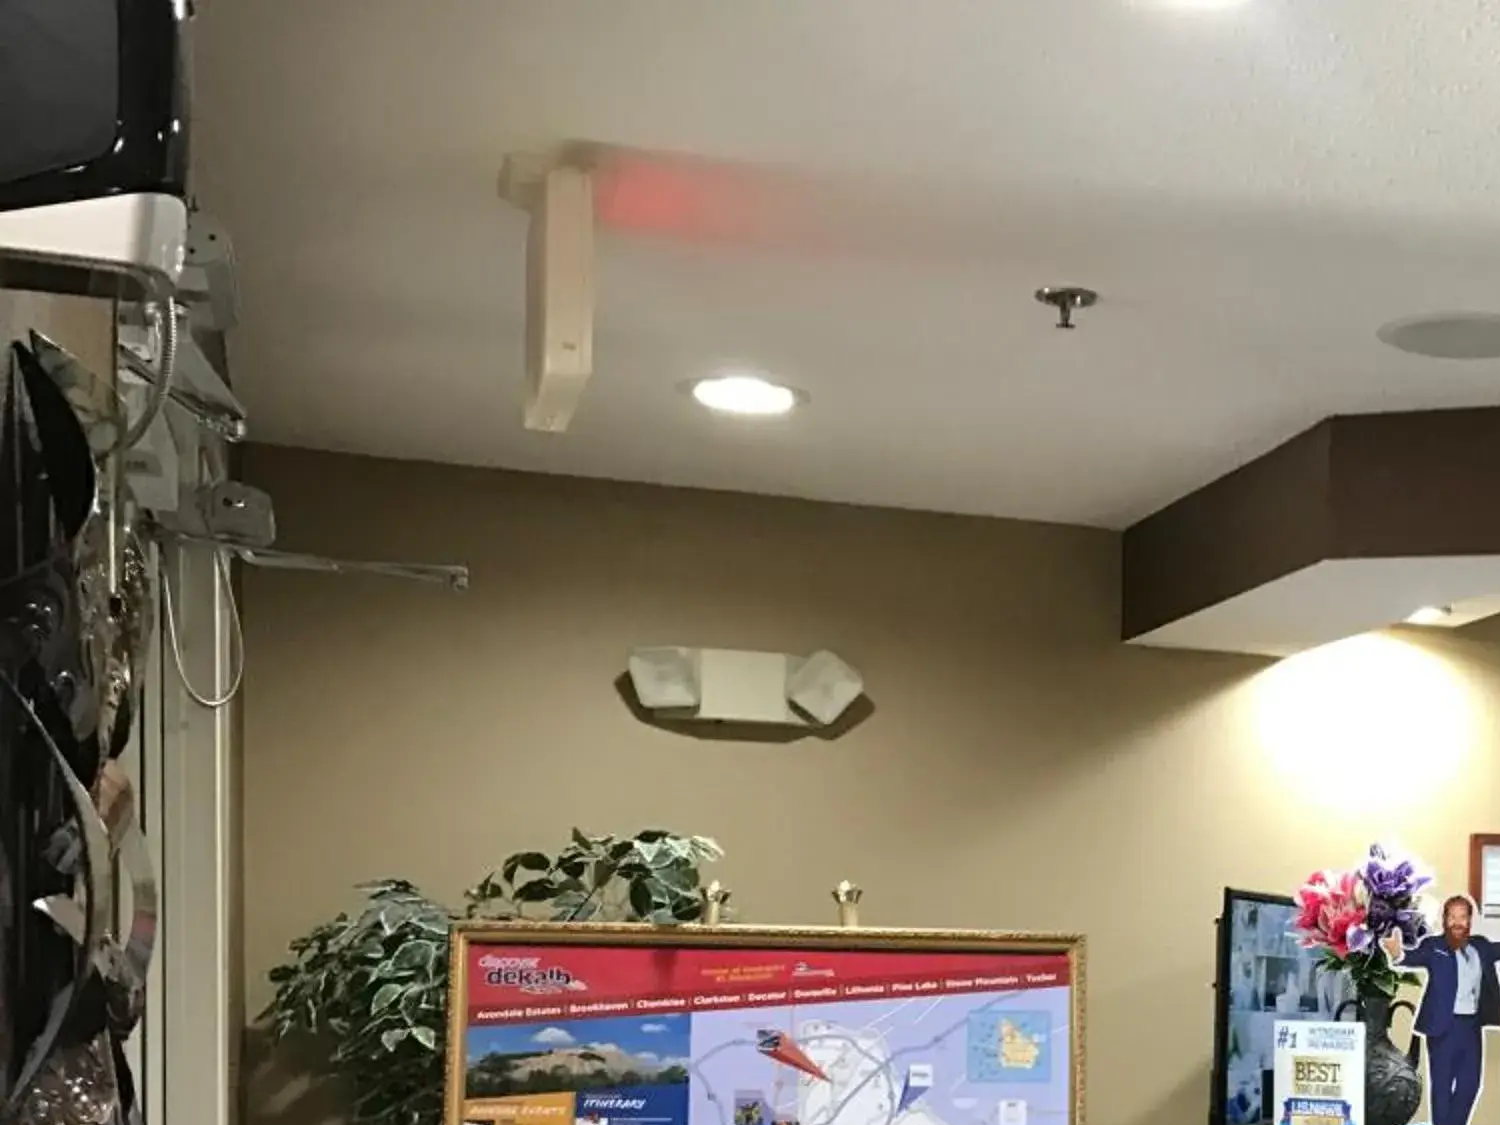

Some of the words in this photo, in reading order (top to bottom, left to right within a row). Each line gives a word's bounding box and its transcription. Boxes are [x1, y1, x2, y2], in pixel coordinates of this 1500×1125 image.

[486, 966, 572, 986] dekalb
[477, 1008, 523, 1020] Avondale
[525, 1006, 561, 1018] Estates
[570, 1002, 628, 1014] Brookhaven
[1277, 1026, 1297, 1048] #1
[1295, 1061, 1341, 1083] BEST
